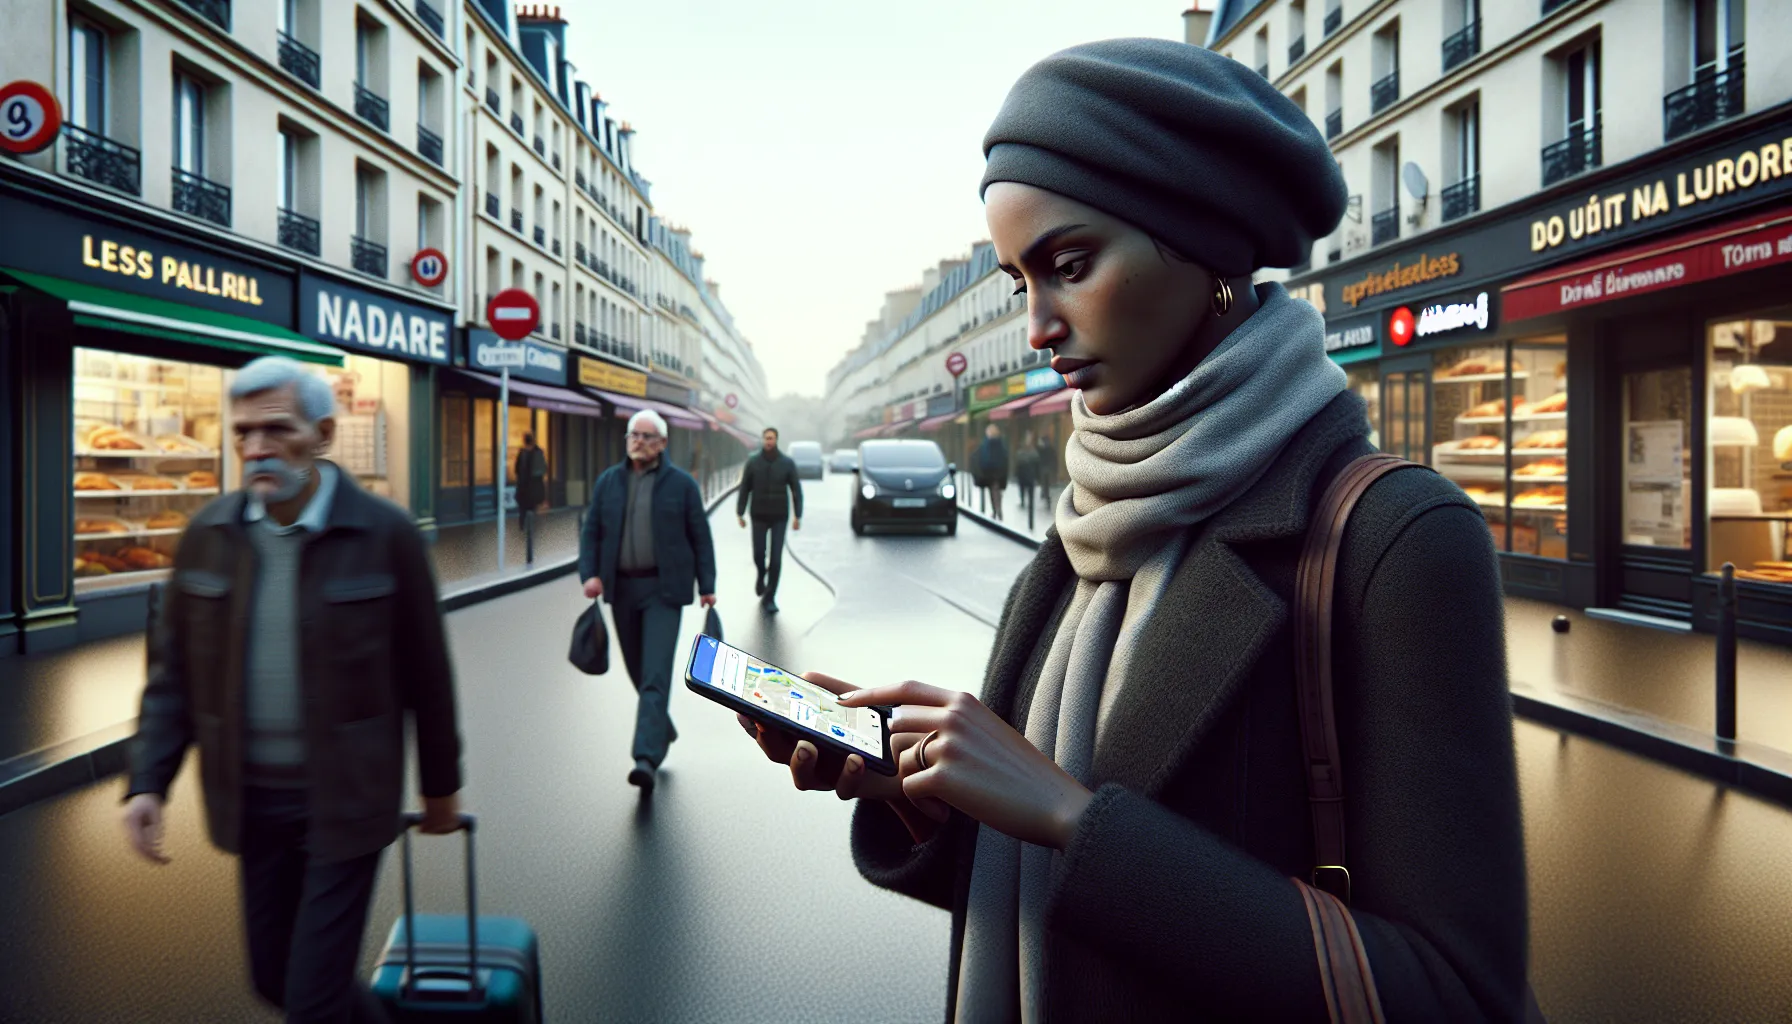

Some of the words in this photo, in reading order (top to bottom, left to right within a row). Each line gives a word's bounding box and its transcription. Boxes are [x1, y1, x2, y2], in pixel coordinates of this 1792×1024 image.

[7, 101, 32, 137] 9
[1531, 214, 1565, 252] DO
[1632, 180, 1669, 221] NA
[82, 234, 154, 280] LESS
[317, 290, 447, 360] NADARE
